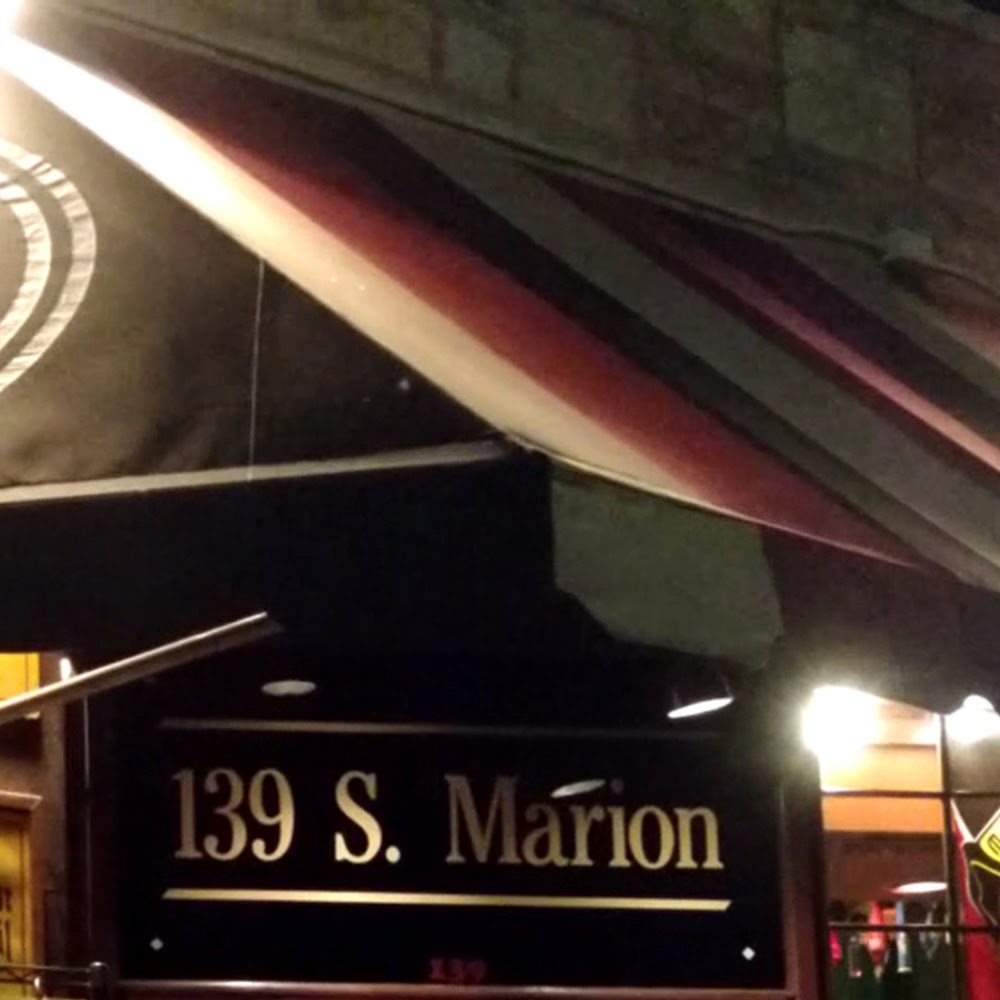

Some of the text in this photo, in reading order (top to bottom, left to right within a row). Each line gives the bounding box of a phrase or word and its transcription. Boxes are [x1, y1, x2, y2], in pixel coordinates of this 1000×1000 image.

[171, 767, 725, 869] 139 S. Marion
